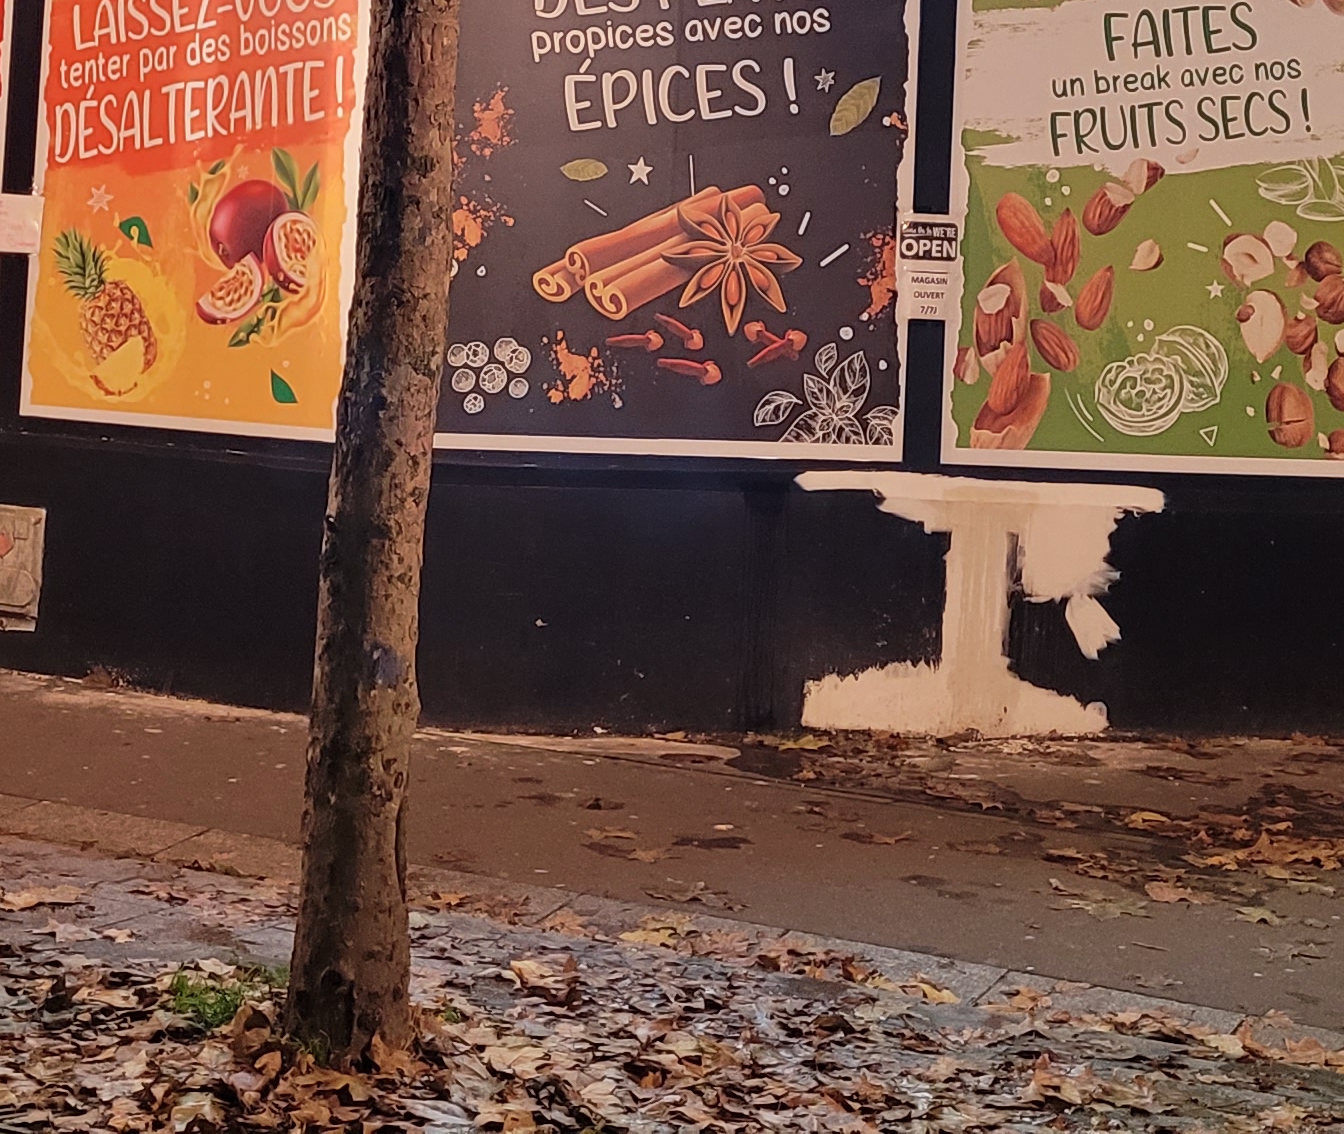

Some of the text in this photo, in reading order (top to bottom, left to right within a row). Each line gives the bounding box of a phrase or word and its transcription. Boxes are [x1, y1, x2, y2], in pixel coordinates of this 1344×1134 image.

[60, 12, 352, 89] tenter par des boissons
[531, 7, 831, 63] propices avec nos
[1103, 2, 1257, 61] FAITES
[564, 57, 800, 132] ÉPICES !
[1052, 58, 1302, 98] un break avec nos
[55, 55, 345, 163] DÉSALTERANTE !
[1050, 87, 1312, 157] FRUITS SECS !
[901, 239, 956, 258] OPEN
[911, 276, 948, 285] MAGASIN
[913, 291, 945, 299] OUVERT
